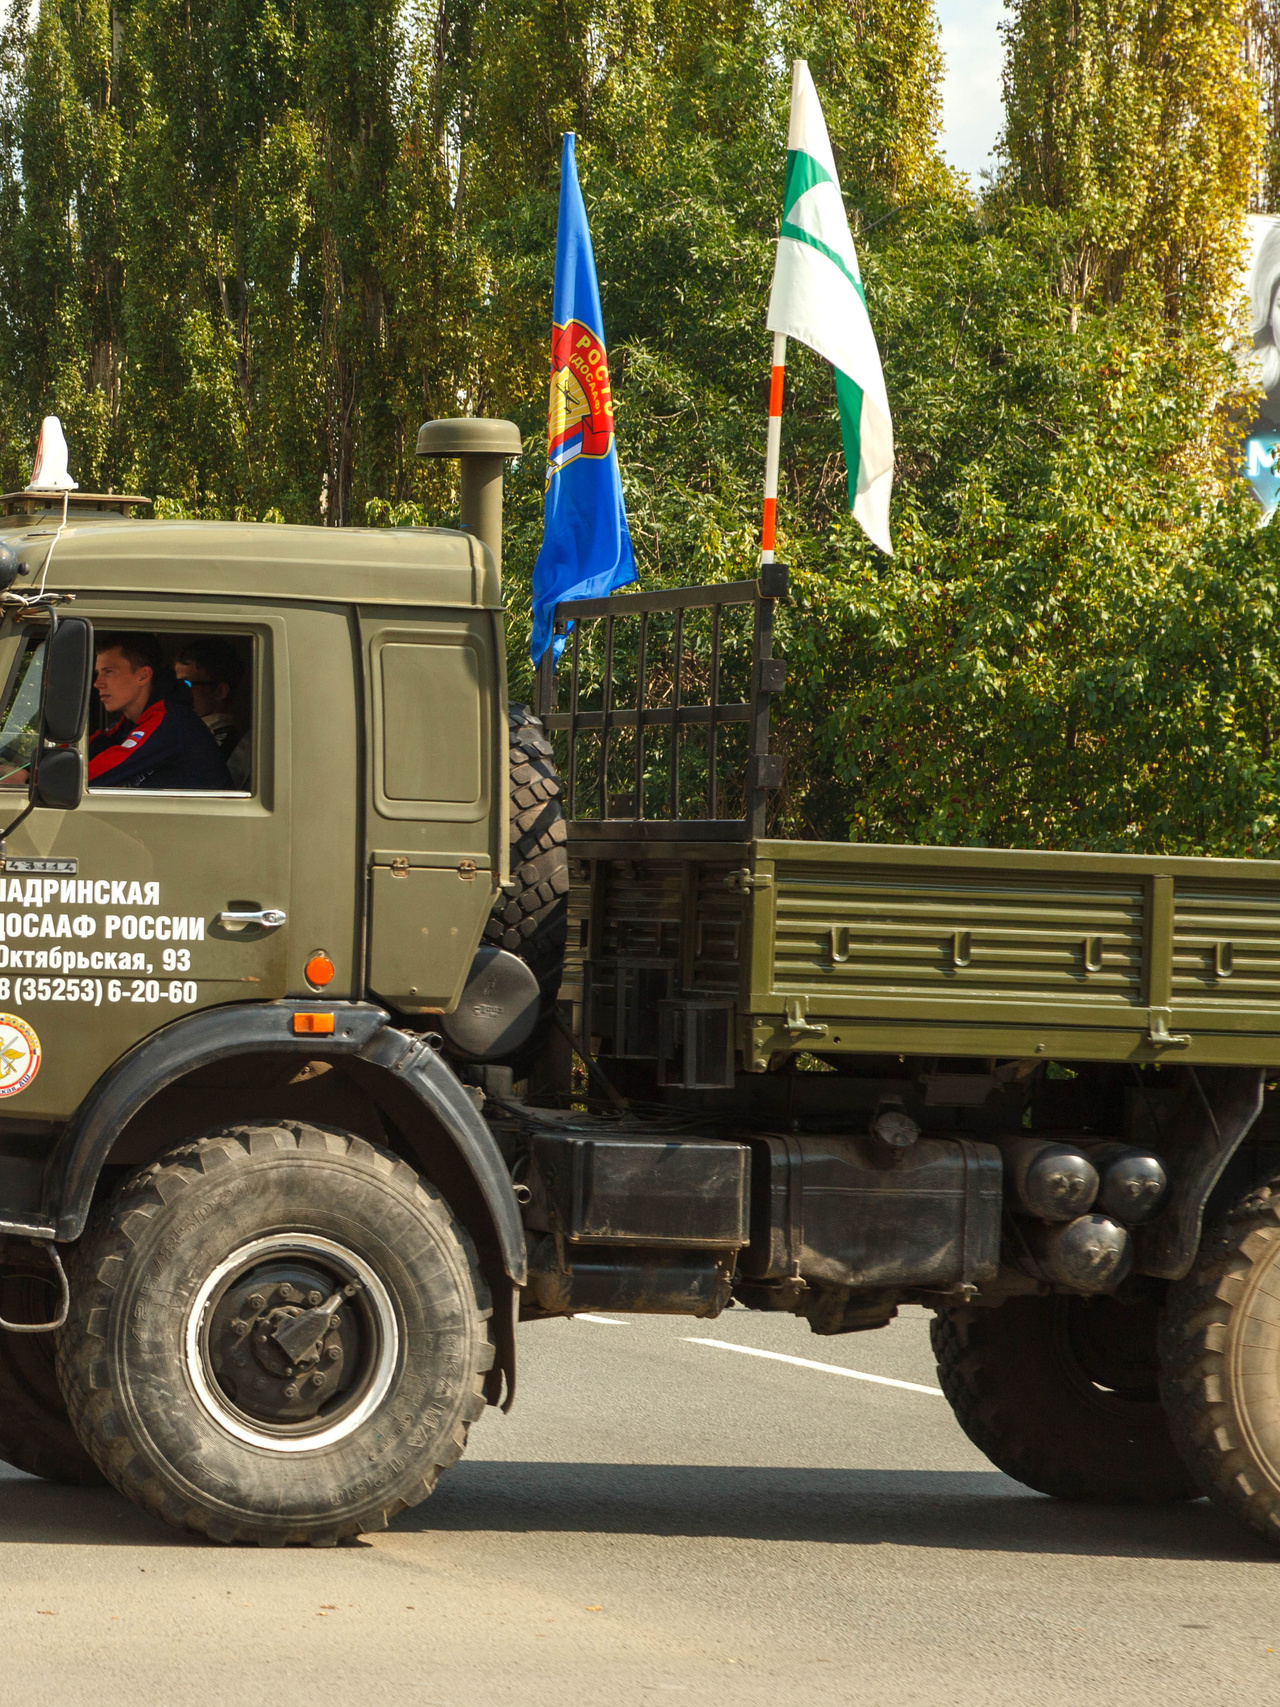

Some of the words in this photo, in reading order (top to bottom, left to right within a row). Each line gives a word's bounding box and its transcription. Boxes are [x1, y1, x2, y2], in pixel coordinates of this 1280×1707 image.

[9, 861, 74, 871] 43114
[104, 914, 205, 941] РОССИИ
[162, 948, 191, 972] 93
[3, 1015, 39, 1049] РОССИИ
[18, 1073, 31, 1087] АШ
